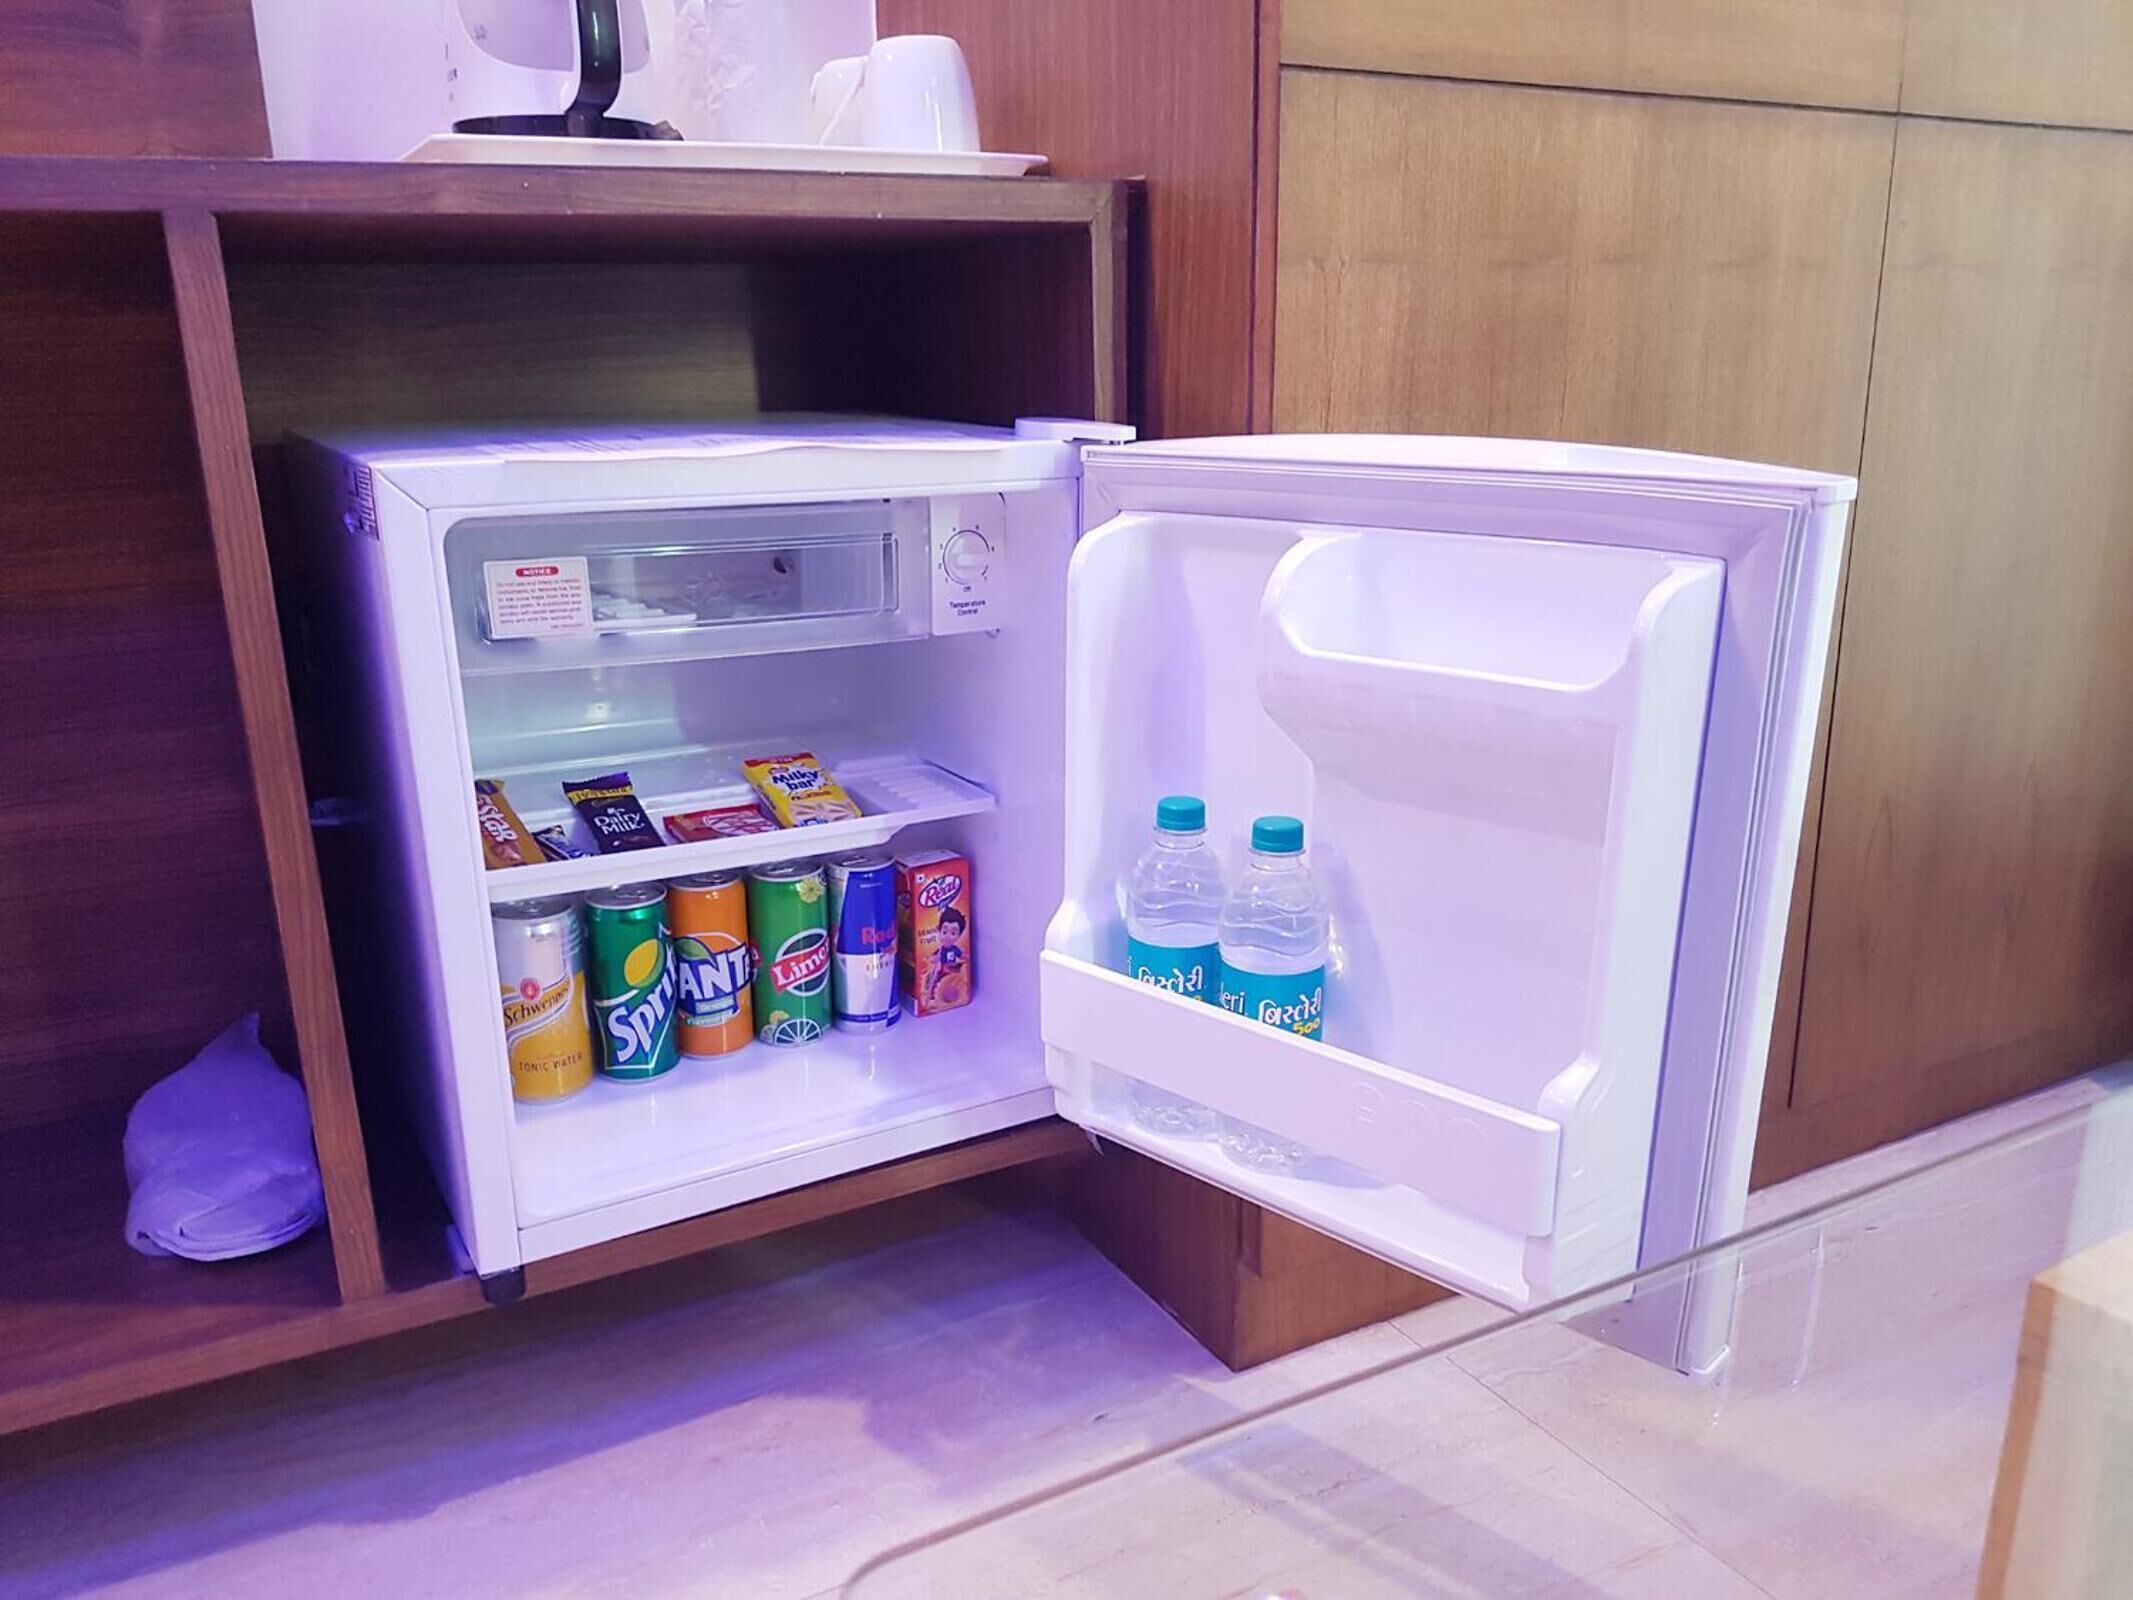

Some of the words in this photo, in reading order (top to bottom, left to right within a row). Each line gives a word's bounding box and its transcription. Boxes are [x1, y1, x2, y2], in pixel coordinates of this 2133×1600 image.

[949, 600, 986, 609] Temperature
[772, 769, 819, 784] Milky
[785, 778, 814, 791] bar
[594, 811, 640, 828] Dairy
[602, 820, 645, 835] Milk
[924, 875, 958, 906] Real
[1293, 1018, 1321, 1035] 500
[519, 1060, 549, 1072] TONIC
[553, 1051, 582, 1069] WATER
